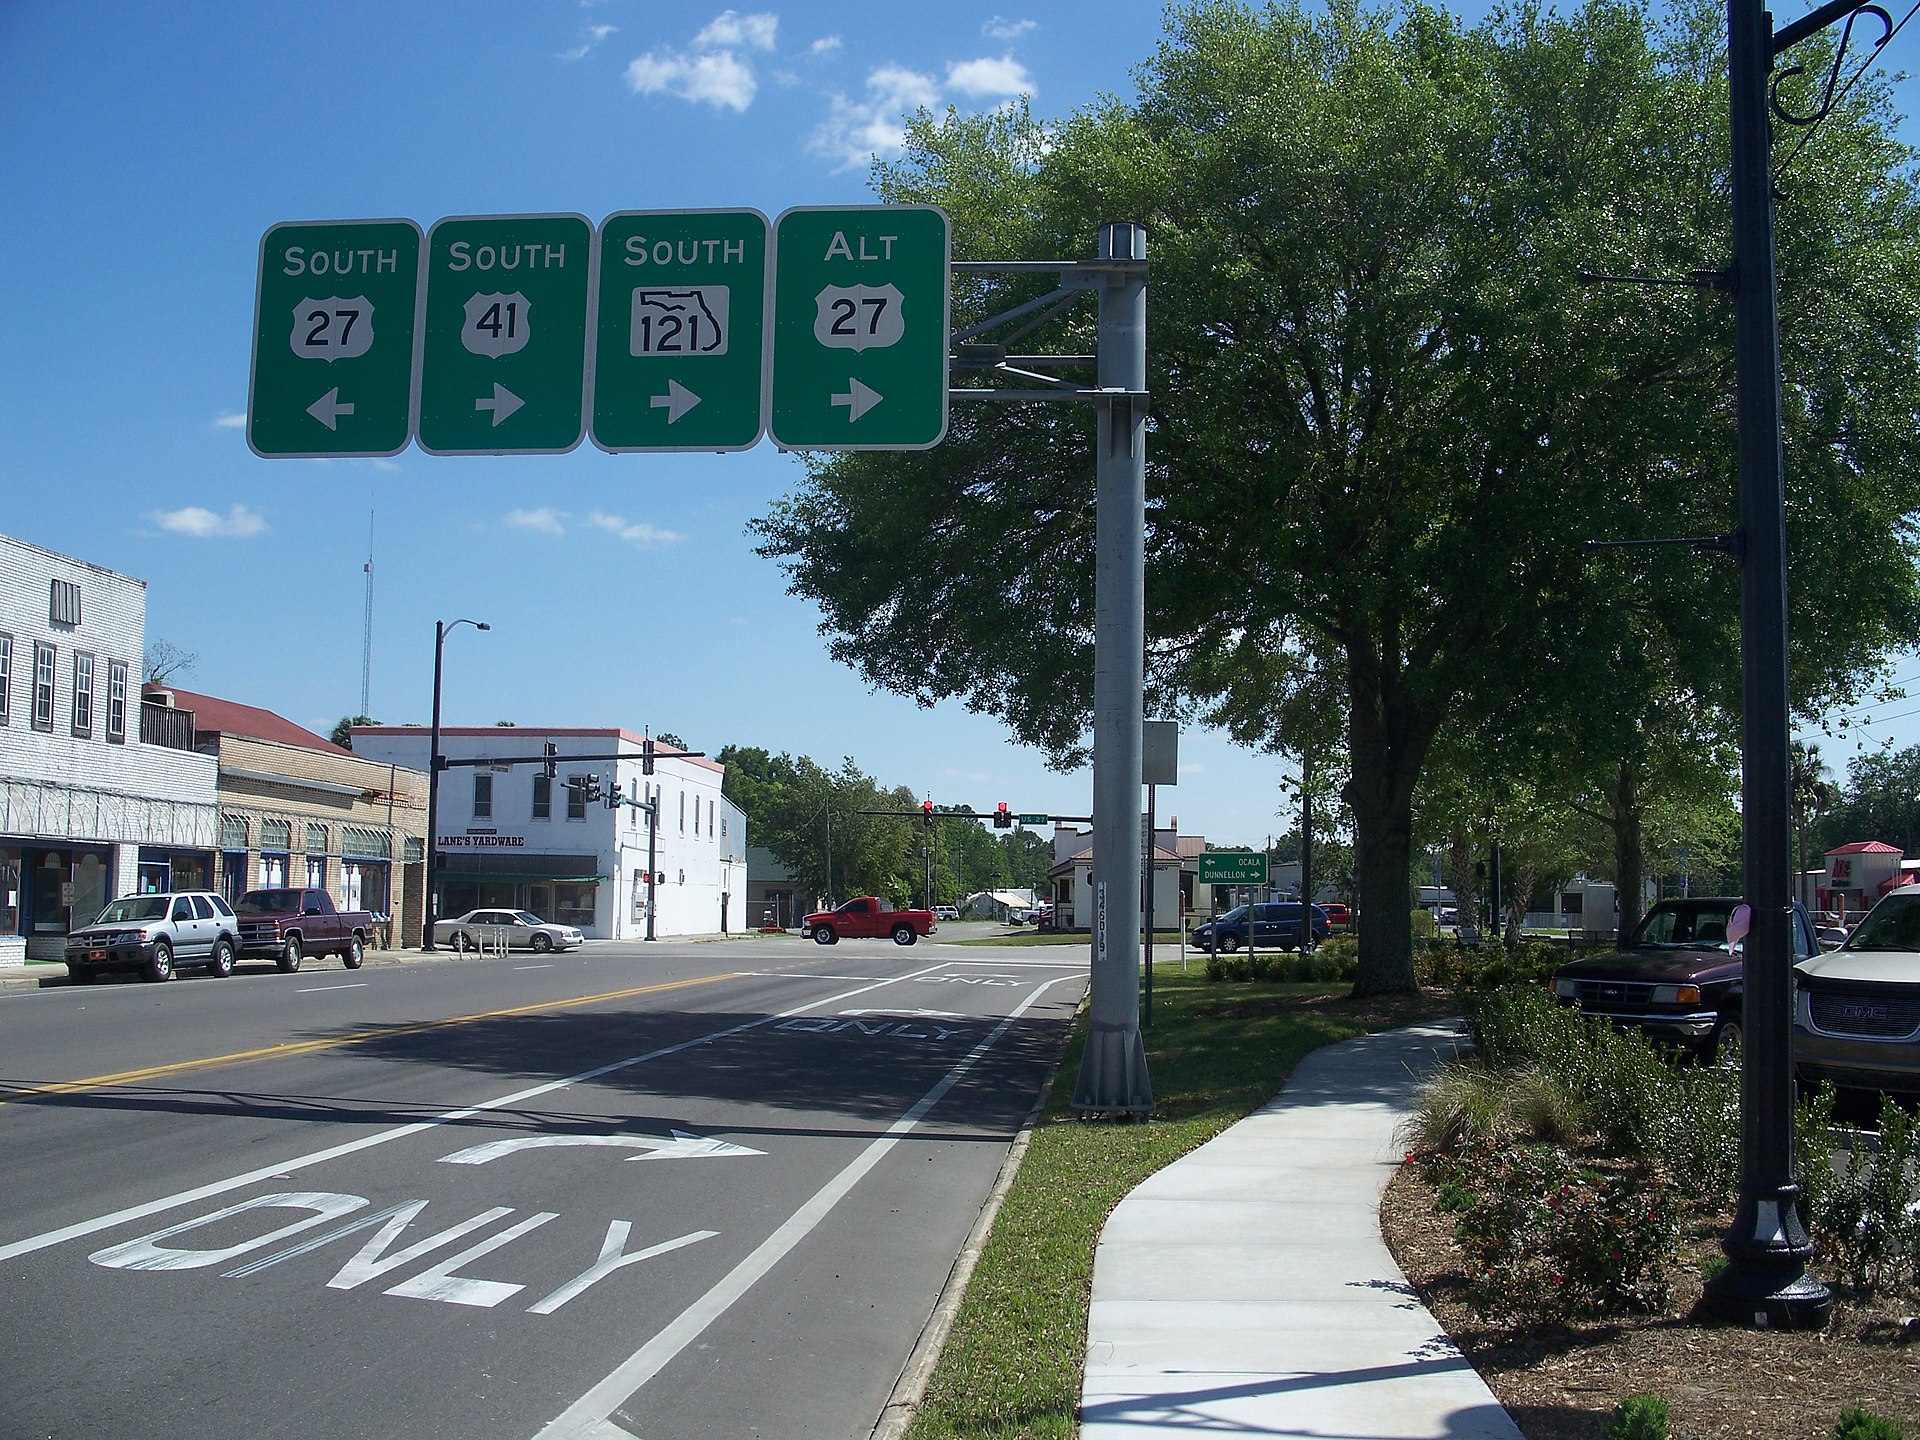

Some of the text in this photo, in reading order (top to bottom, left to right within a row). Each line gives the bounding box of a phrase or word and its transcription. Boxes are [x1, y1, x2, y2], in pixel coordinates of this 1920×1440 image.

[283, 246, 397, 276] SOUTH
[448, 241, 565, 271] SOUTH
[624, 236, 745, 266] SOUTH
[824, 231, 898, 261] ALT
[305, 310, 359, 346] 27
[476, 302, 516, 338] 41
[830, 298, 888, 335] 27
[641, 315, 698, 351] 121
[438, 836, 524, 846] LANE'S YARDWARE
[1204, 871, 1246, 879] DUNNELLON
[1238, 858, 1261, 866] OCALA
[914, 976, 1033, 988] ONLY
[1842, 1005, 1887, 1019] GMC
[774, 1018, 974, 1041] ONLY
[87, 1191, 721, 1316] ONLY
